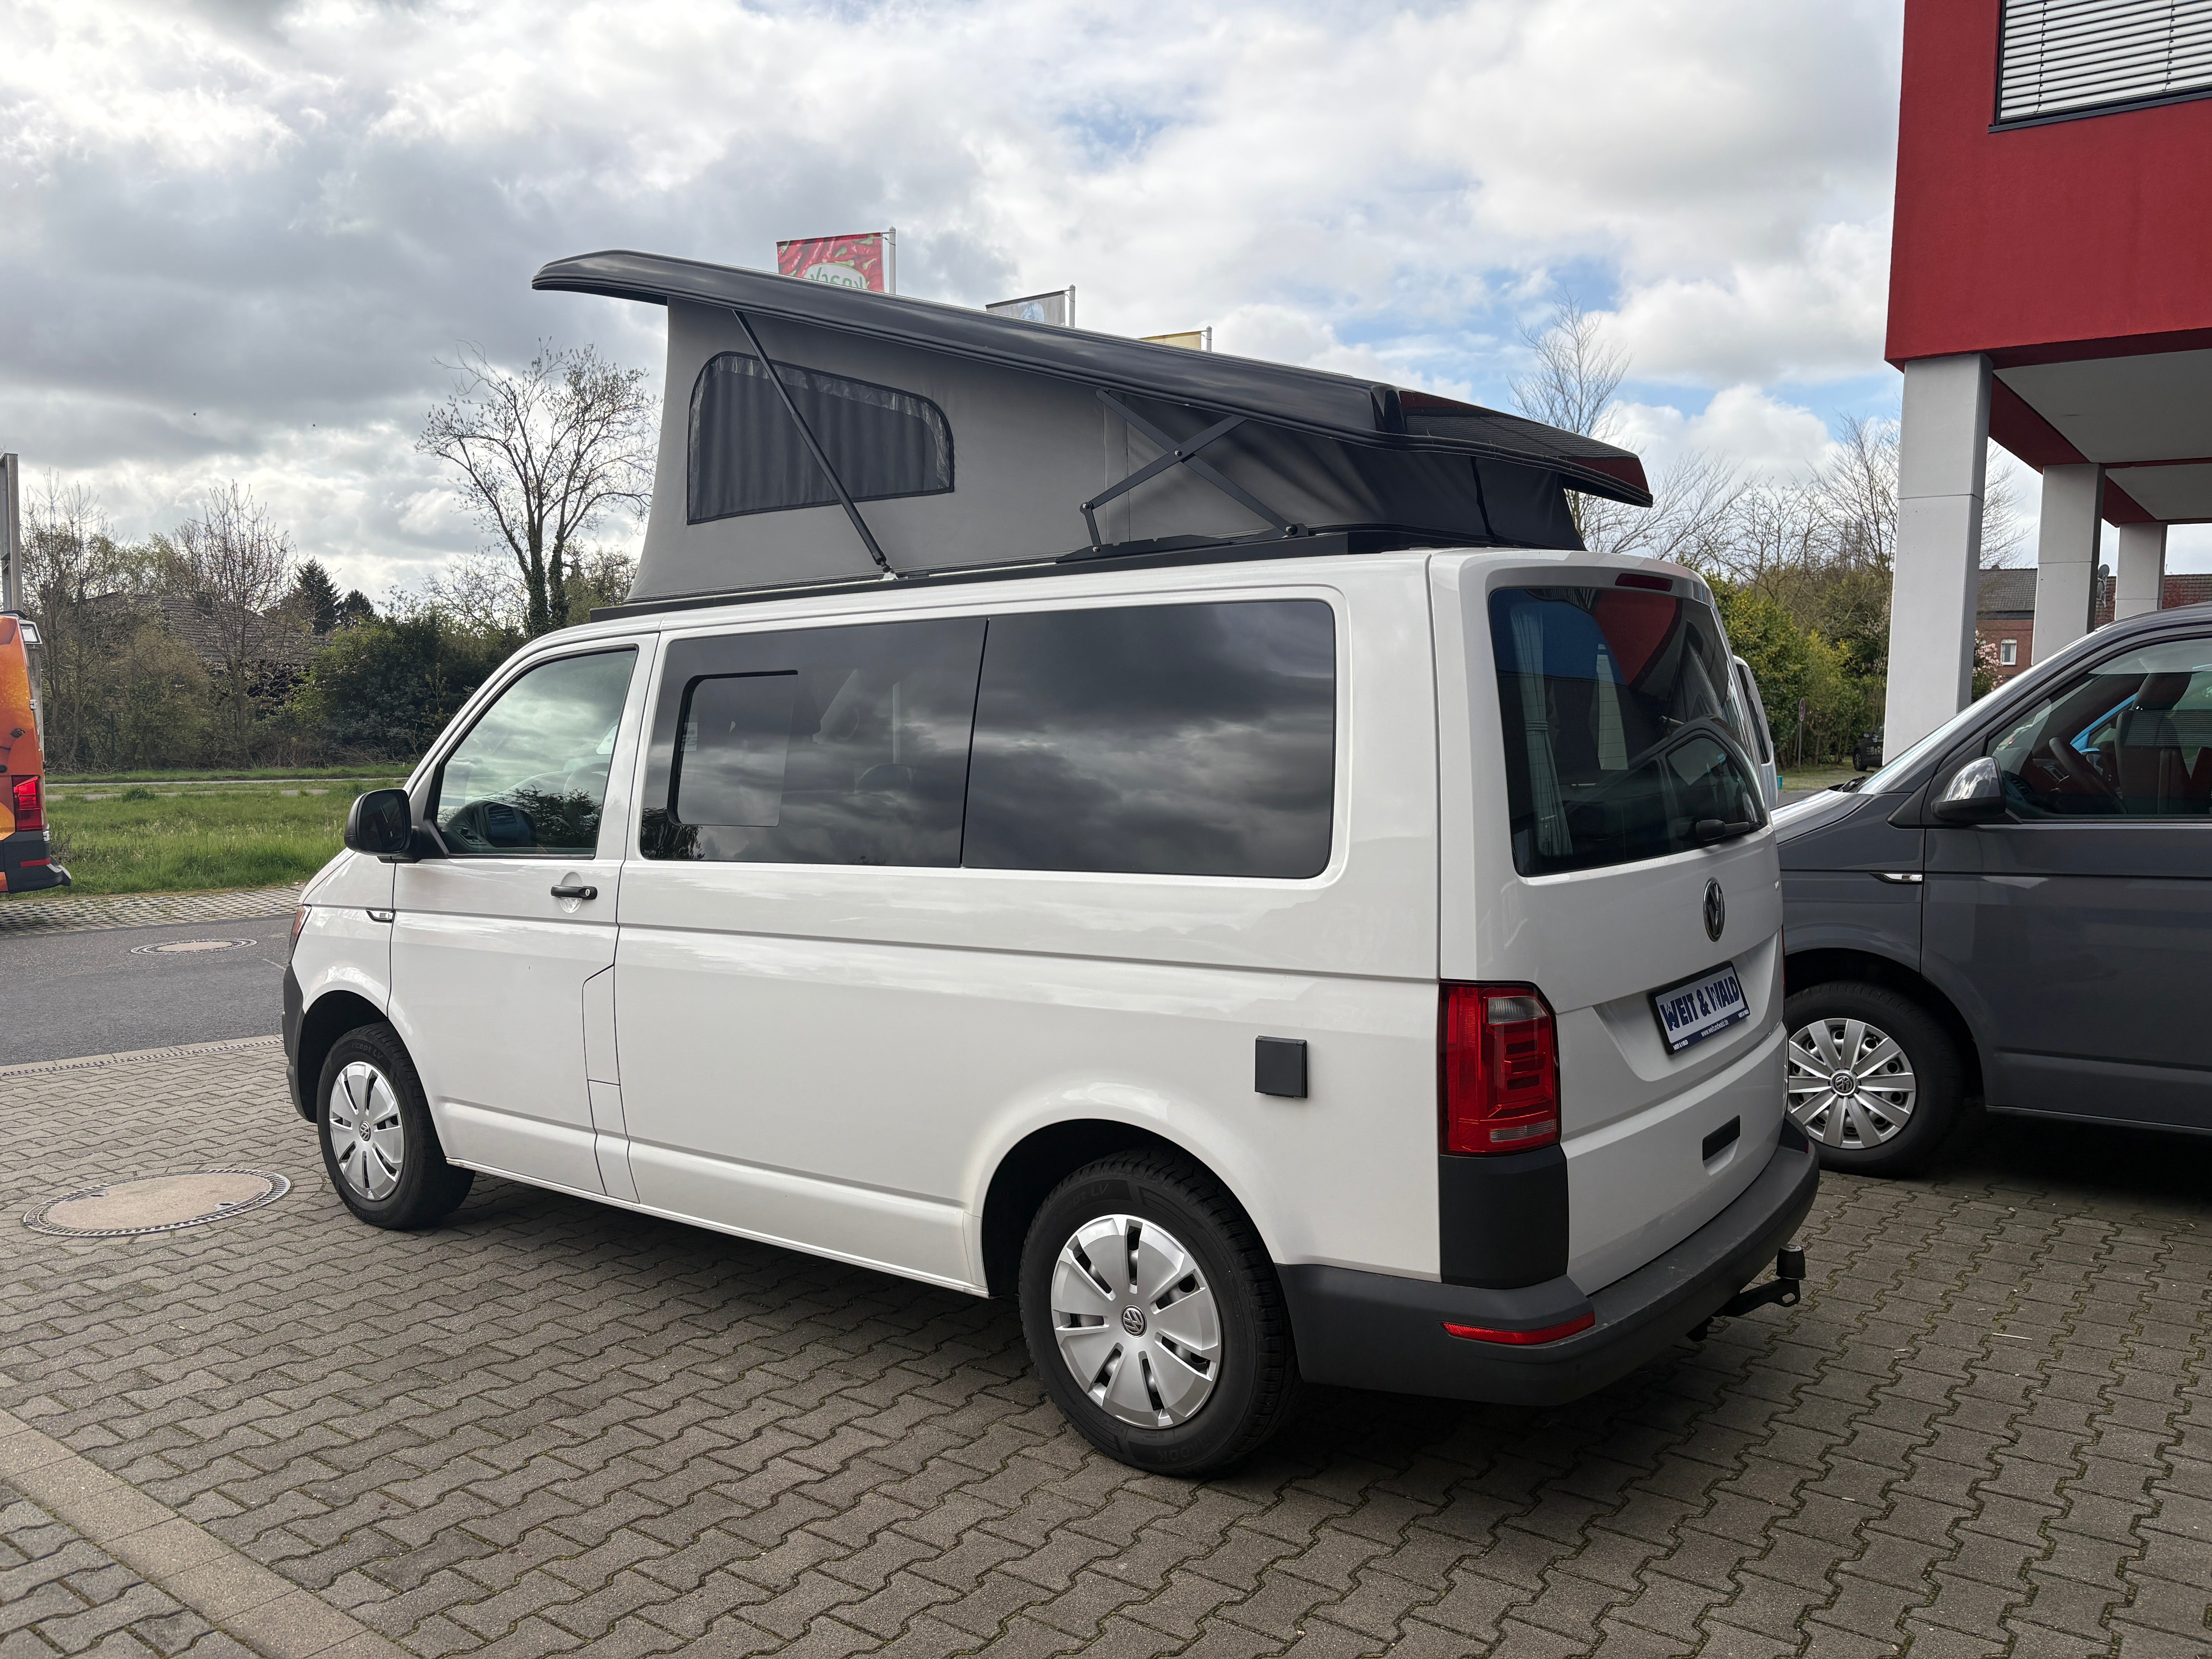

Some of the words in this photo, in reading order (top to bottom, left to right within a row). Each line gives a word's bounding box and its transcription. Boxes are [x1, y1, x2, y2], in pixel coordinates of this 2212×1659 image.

[1660, 993, 1699, 1031] WEIT
[1696, 989, 1711, 1017] &
[1705, 976, 1740, 1011] WALD
